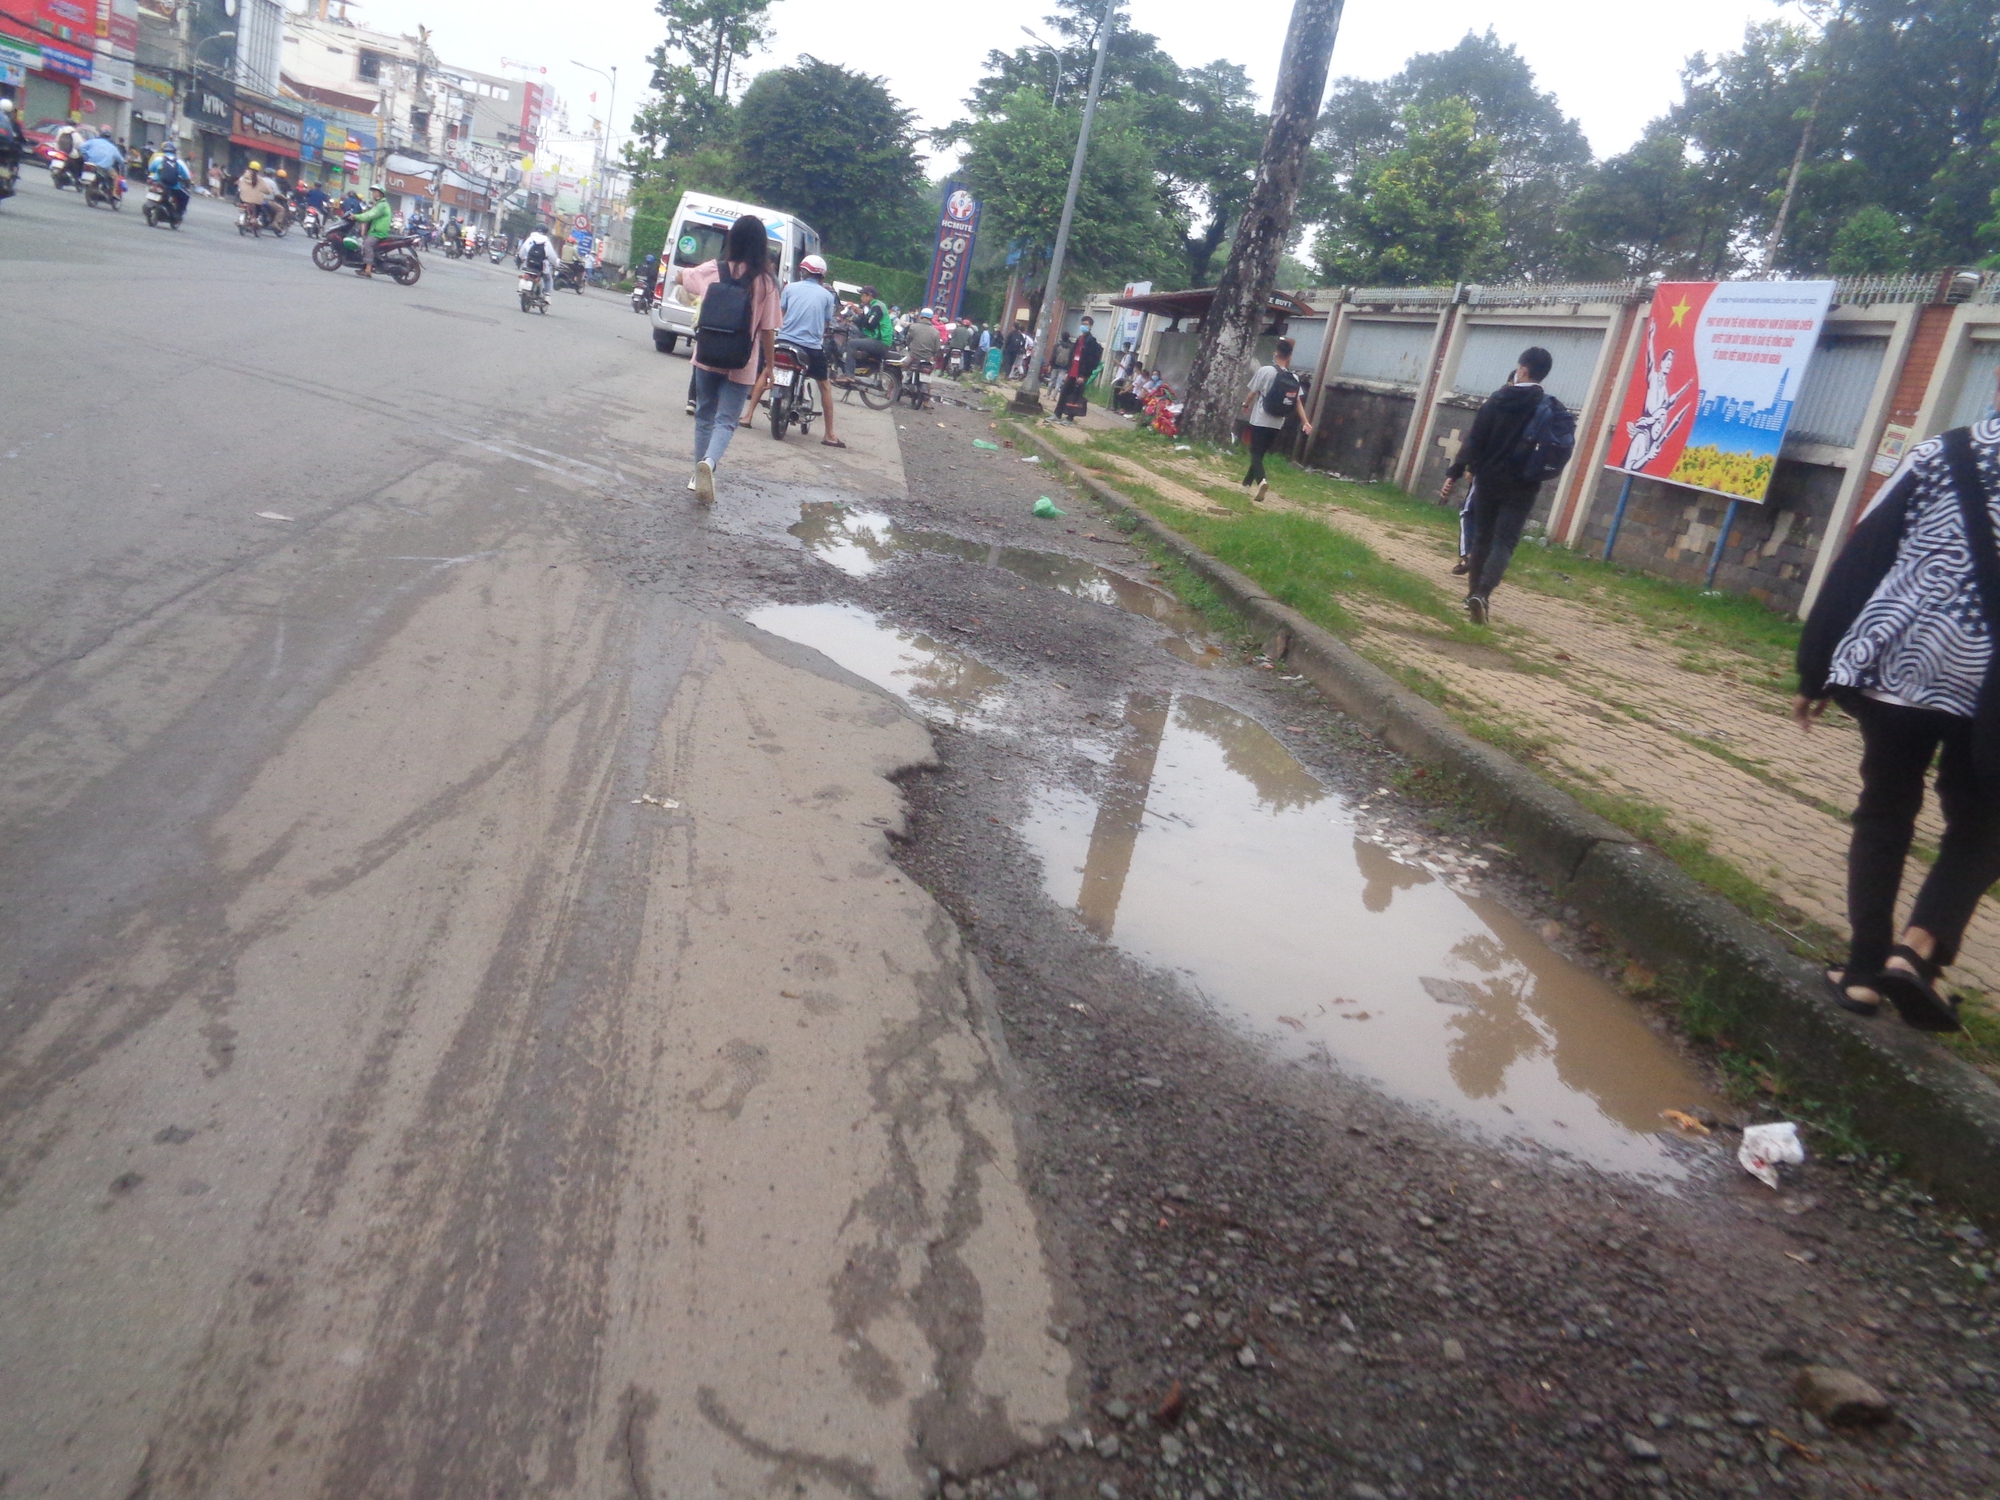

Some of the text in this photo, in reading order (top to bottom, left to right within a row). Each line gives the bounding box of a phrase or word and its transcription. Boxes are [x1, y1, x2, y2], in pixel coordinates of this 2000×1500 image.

[202, 93, 229, 118] MWC
[941, 219, 974, 231] HCMUTE
[940, 237, 966, 254] 60
